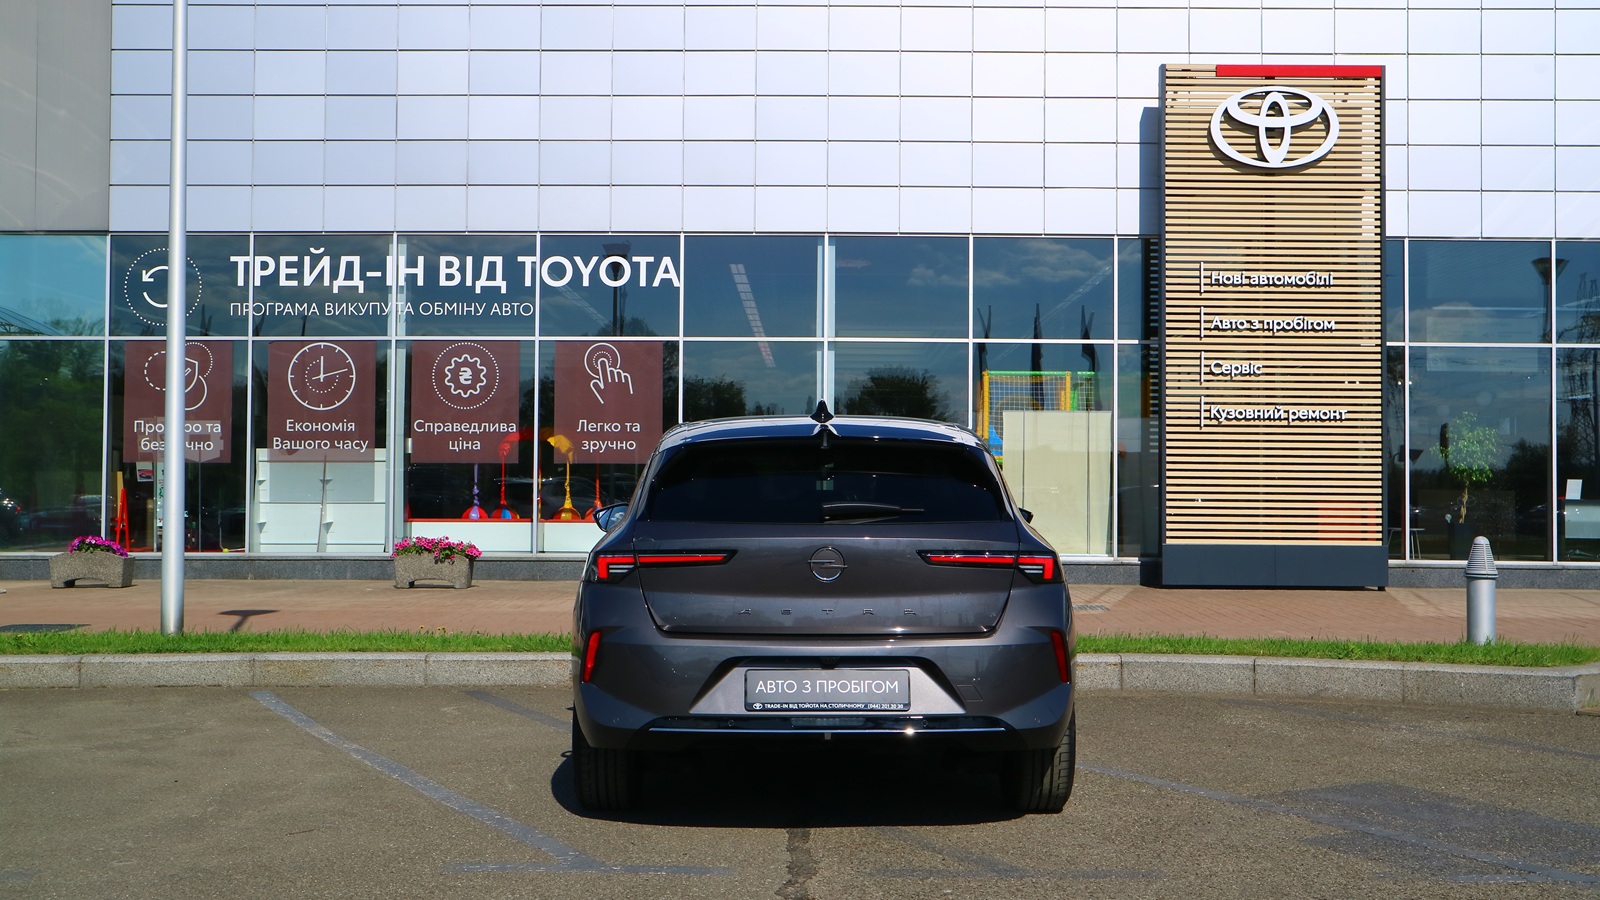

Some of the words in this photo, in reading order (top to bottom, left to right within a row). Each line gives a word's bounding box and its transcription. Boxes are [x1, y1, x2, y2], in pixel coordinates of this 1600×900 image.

[229, 247, 425, 294] ТРЕЙД-ІН
[438, 255, 507, 294] ВІД
[517, 255, 680, 288] TOYOTA
[1210, 271, 1246, 285] Нові
[1250, 271, 1334, 286] автомобілі
[230, 302, 320, 316] ПРОГРАМА
[324, 302, 392, 316] ВИКУПУ
[395, 302, 414, 316] ТА
[419, 302, 487, 316] ОБМІНУ
[490, 302, 534, 316] АВТО
[1210, 316, 1247, 330] Авто
[1250, 321, 1260, 330] з
[1263, 315, 1336, 334] пробігом
[1210, 360, 1263, 377] Сервіс
[1210, 405, 1285, 421] Кузовний
[1288, 409, 1348, 423] ремонт
[205, 423, 221, 433] та
[285, 419, 355, 432] Економія
[413, 419, 517, 433] Справедлива
[576, 420, 621, 433] Легко
[624, 423, 641, 432] та
[140, 437, 214, 451] безчно
[272, 437, 331, 450] Вашого
[333, 441, 369, 453] часу
[449, 438, 481, 450] ціна
[581, 439, 637, 452] зручно
[755, 680, 798, 694] АВТО
[816, 680, 899, 694] ПРОБІГОМ
